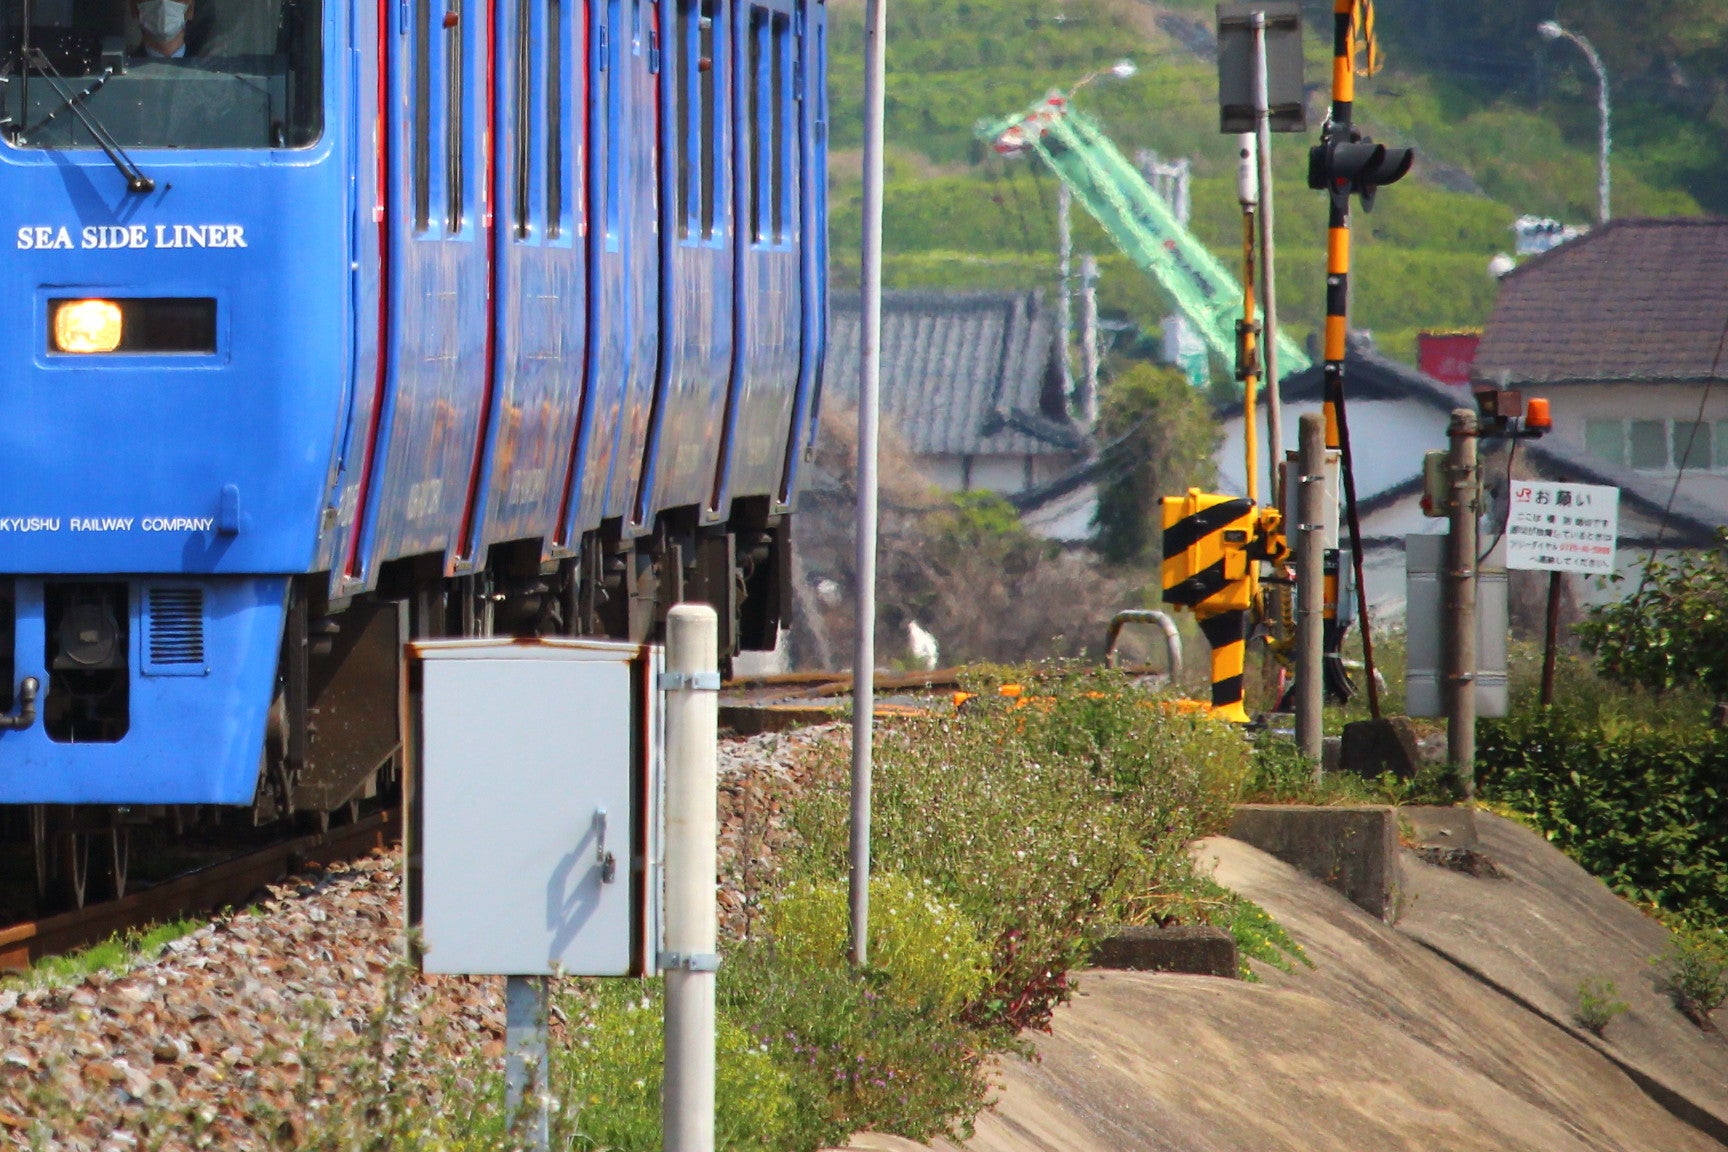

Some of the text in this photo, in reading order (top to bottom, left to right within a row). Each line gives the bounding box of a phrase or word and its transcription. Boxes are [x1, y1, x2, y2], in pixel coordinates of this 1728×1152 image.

[17, 225, 248, 249] SEA SIDE LINER
[0, 518, 214, 532] KYUSHU RAILWAY COMPANY
